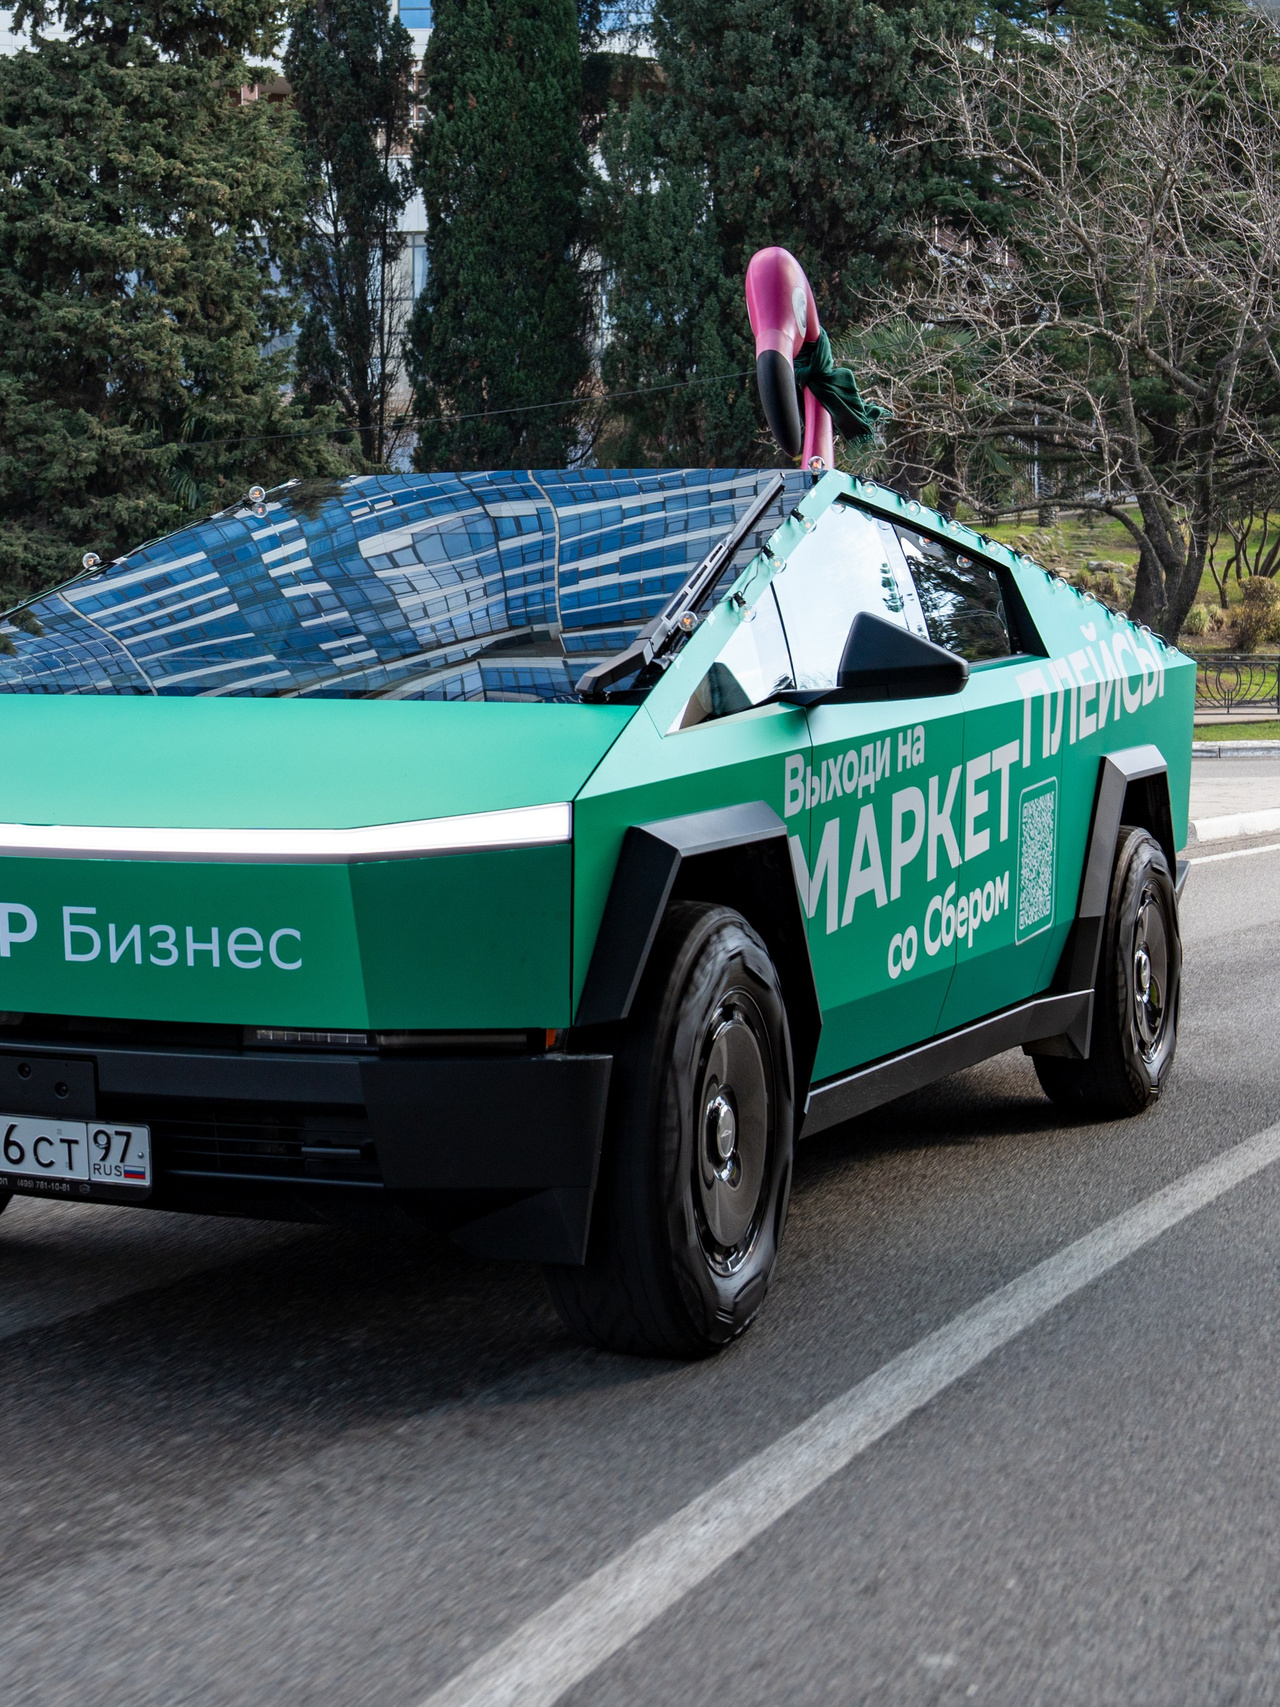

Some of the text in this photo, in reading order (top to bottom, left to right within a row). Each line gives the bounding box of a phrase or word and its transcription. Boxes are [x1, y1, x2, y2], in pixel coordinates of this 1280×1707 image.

[1016, 622, 1165, 767] ПЛЕЙСЫ
[784, 724, 925, 819] Выходи на
[788, 740, 1020, 935] МАРКЕТ
[63, 906, 302, 970] Бизнес
[887, 870, 1009, 980] со Сбером
[93, 1128, 132, 1163] 97
[93, 1163, 122, 1177] RUS
